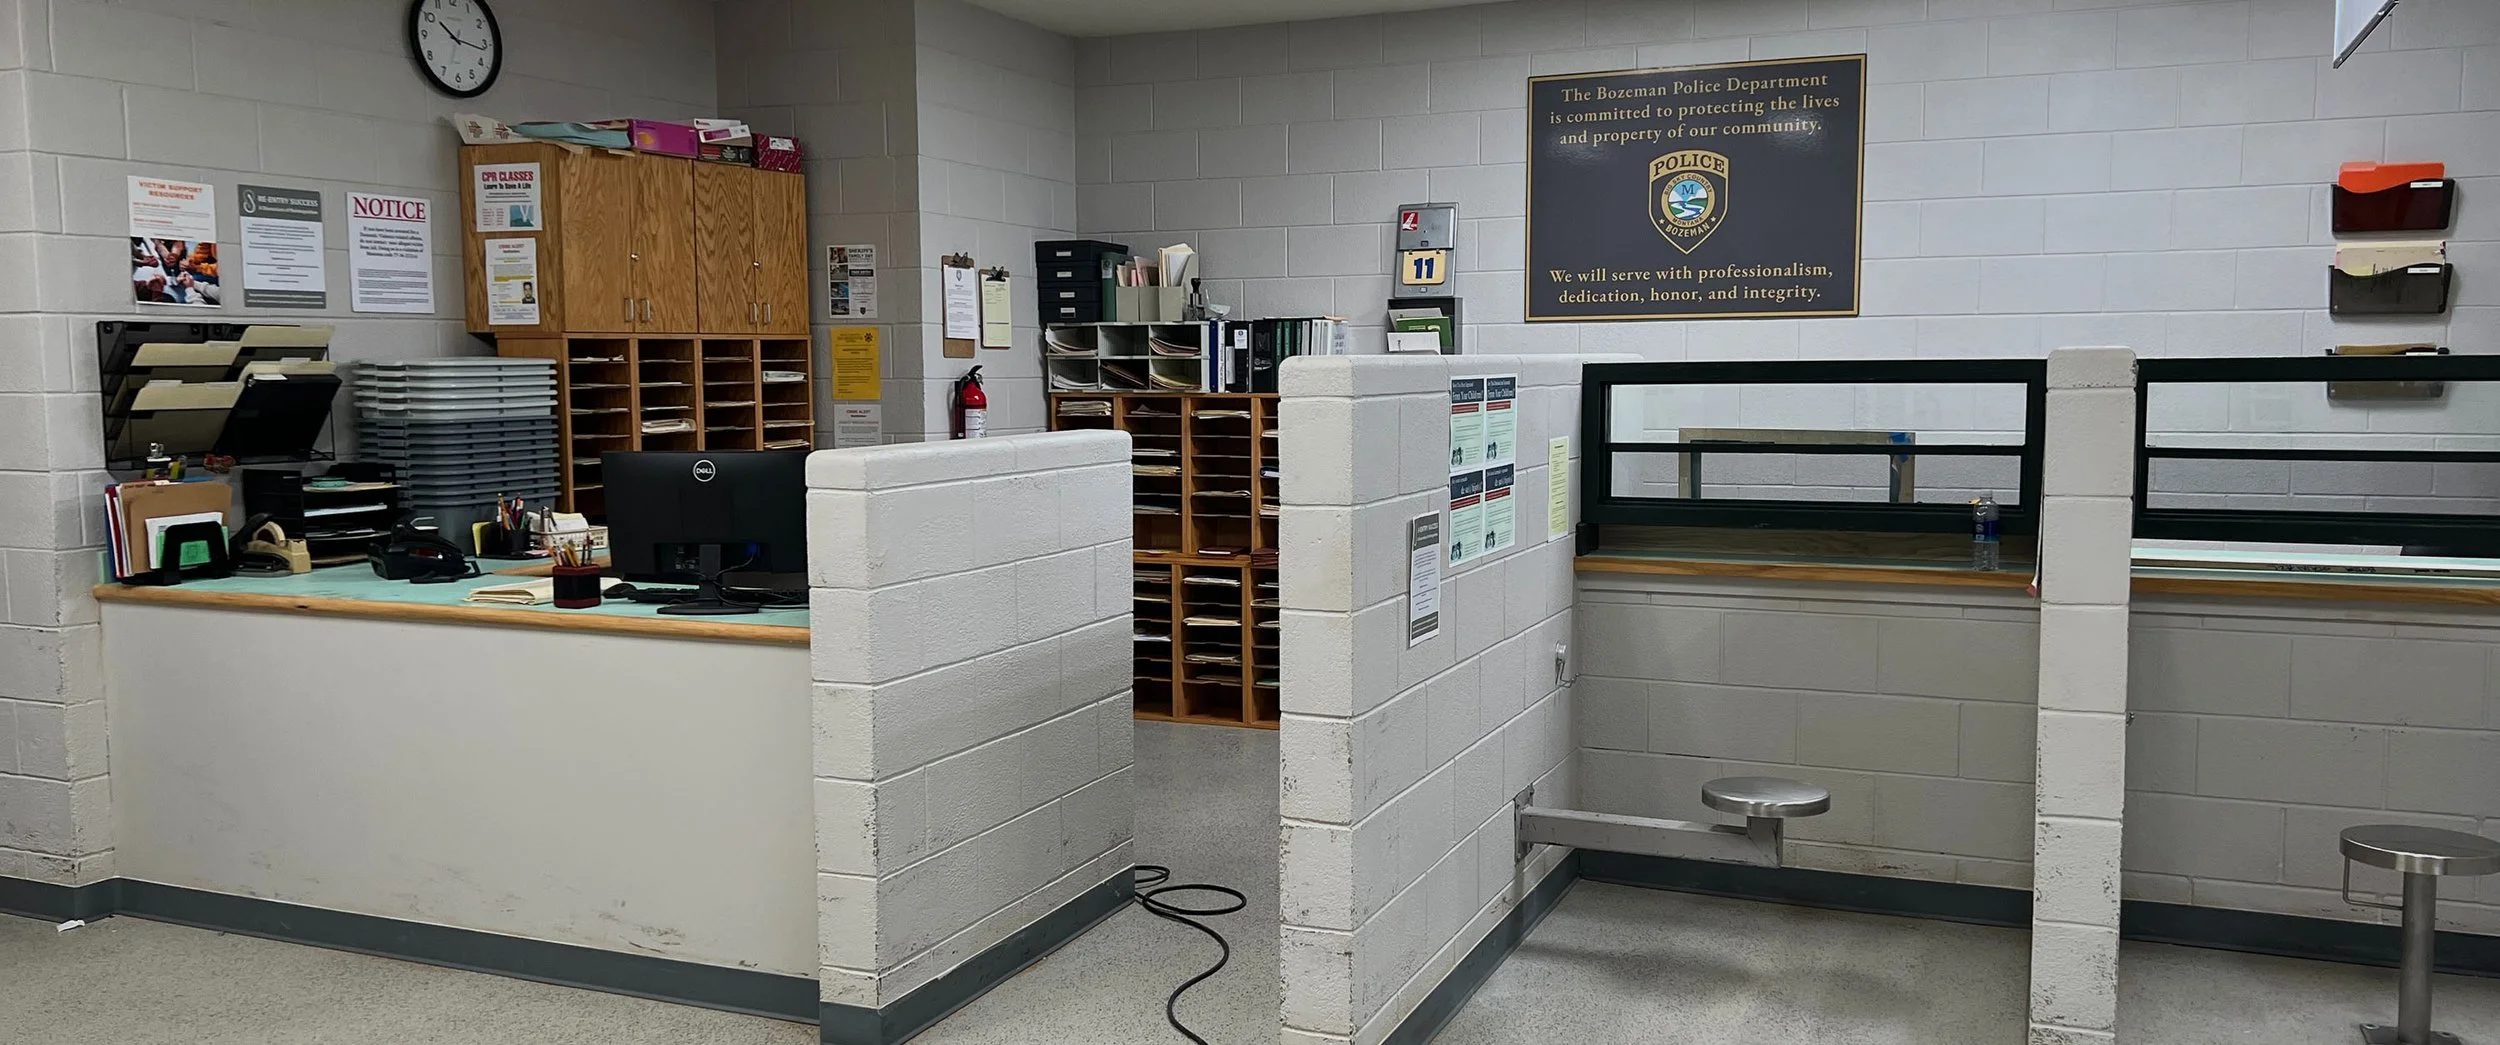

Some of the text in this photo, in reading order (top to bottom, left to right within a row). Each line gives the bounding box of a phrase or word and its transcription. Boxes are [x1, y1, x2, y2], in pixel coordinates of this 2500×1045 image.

[465, 3, 470, 14] 1
[423, 11, 436, 23] 10
[475, 18, 482, 29] 2
[421, 29, 428, 40] 9
[481, 39, 488, 50] 3
[427, 50, 433, 61] 8
[478, 57, 484, 67] 4
[440, 65, 447, 76] 7
[469, 69, 475, 80] 5
[455, 73, 462, 83] 6
[1561, 73, 1829, 103] The Bozeman Police Department
[1550, 94, 1841, 125] is committed to protecting the lives
[1559, 117, 1823, 148] and property of our community.
[1653, 153, 1725, 177] POLICE
[482, 171, 534, 182] CPR CLASSES
[139, 181, 202, 193] VICTIM SUPPORT
[1673, 174, 1685, 188] SKY
[1686, 173, 1713, 194] COUNTRY
[1681, 184, 1695, 195] M
[353, 196, 426, 220] NOTICE
[1672, 217, 1705, 227] MONTANA
[1665, 222, 1710, 238] BOZEMAN
[1414, 257, 1435, 280] 11
[1549, 262, 1834, 284] We will serve with professionalism,
[1558, 284, 1822, 305] dedication, honor, and integrity.
